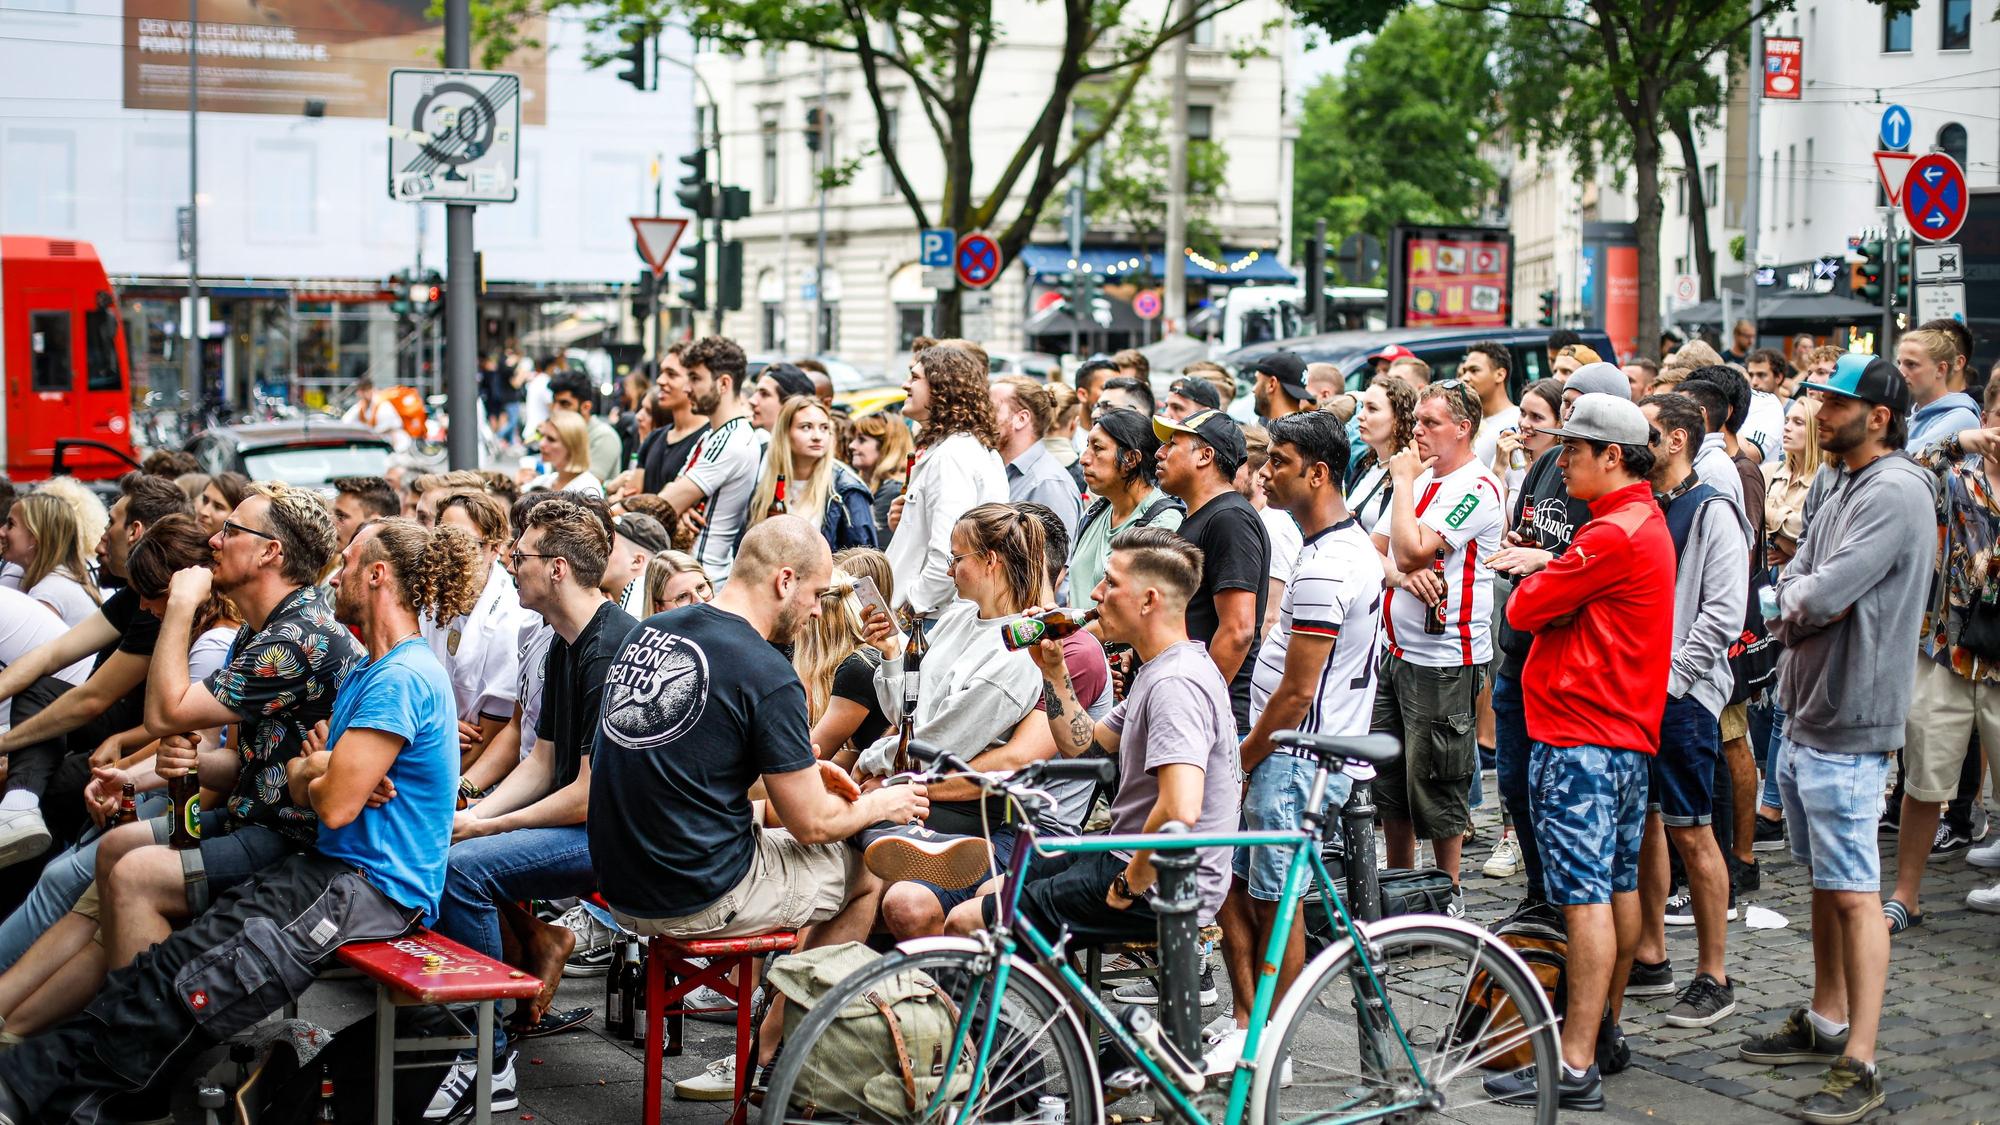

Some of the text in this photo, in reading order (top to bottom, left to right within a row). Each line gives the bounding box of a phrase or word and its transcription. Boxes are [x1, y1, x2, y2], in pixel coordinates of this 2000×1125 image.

[1766, 40, 1801, 55] REWE
[924, 234, 943, 263] P
[1449, 497, 1476, 525] DEVK
[1533, 510, 1574, 545] ALDING.
[638, 626, 682, 651] THE
[620, 643, 669, 670] IRON
[605, 664, 655, 690] DEATH
